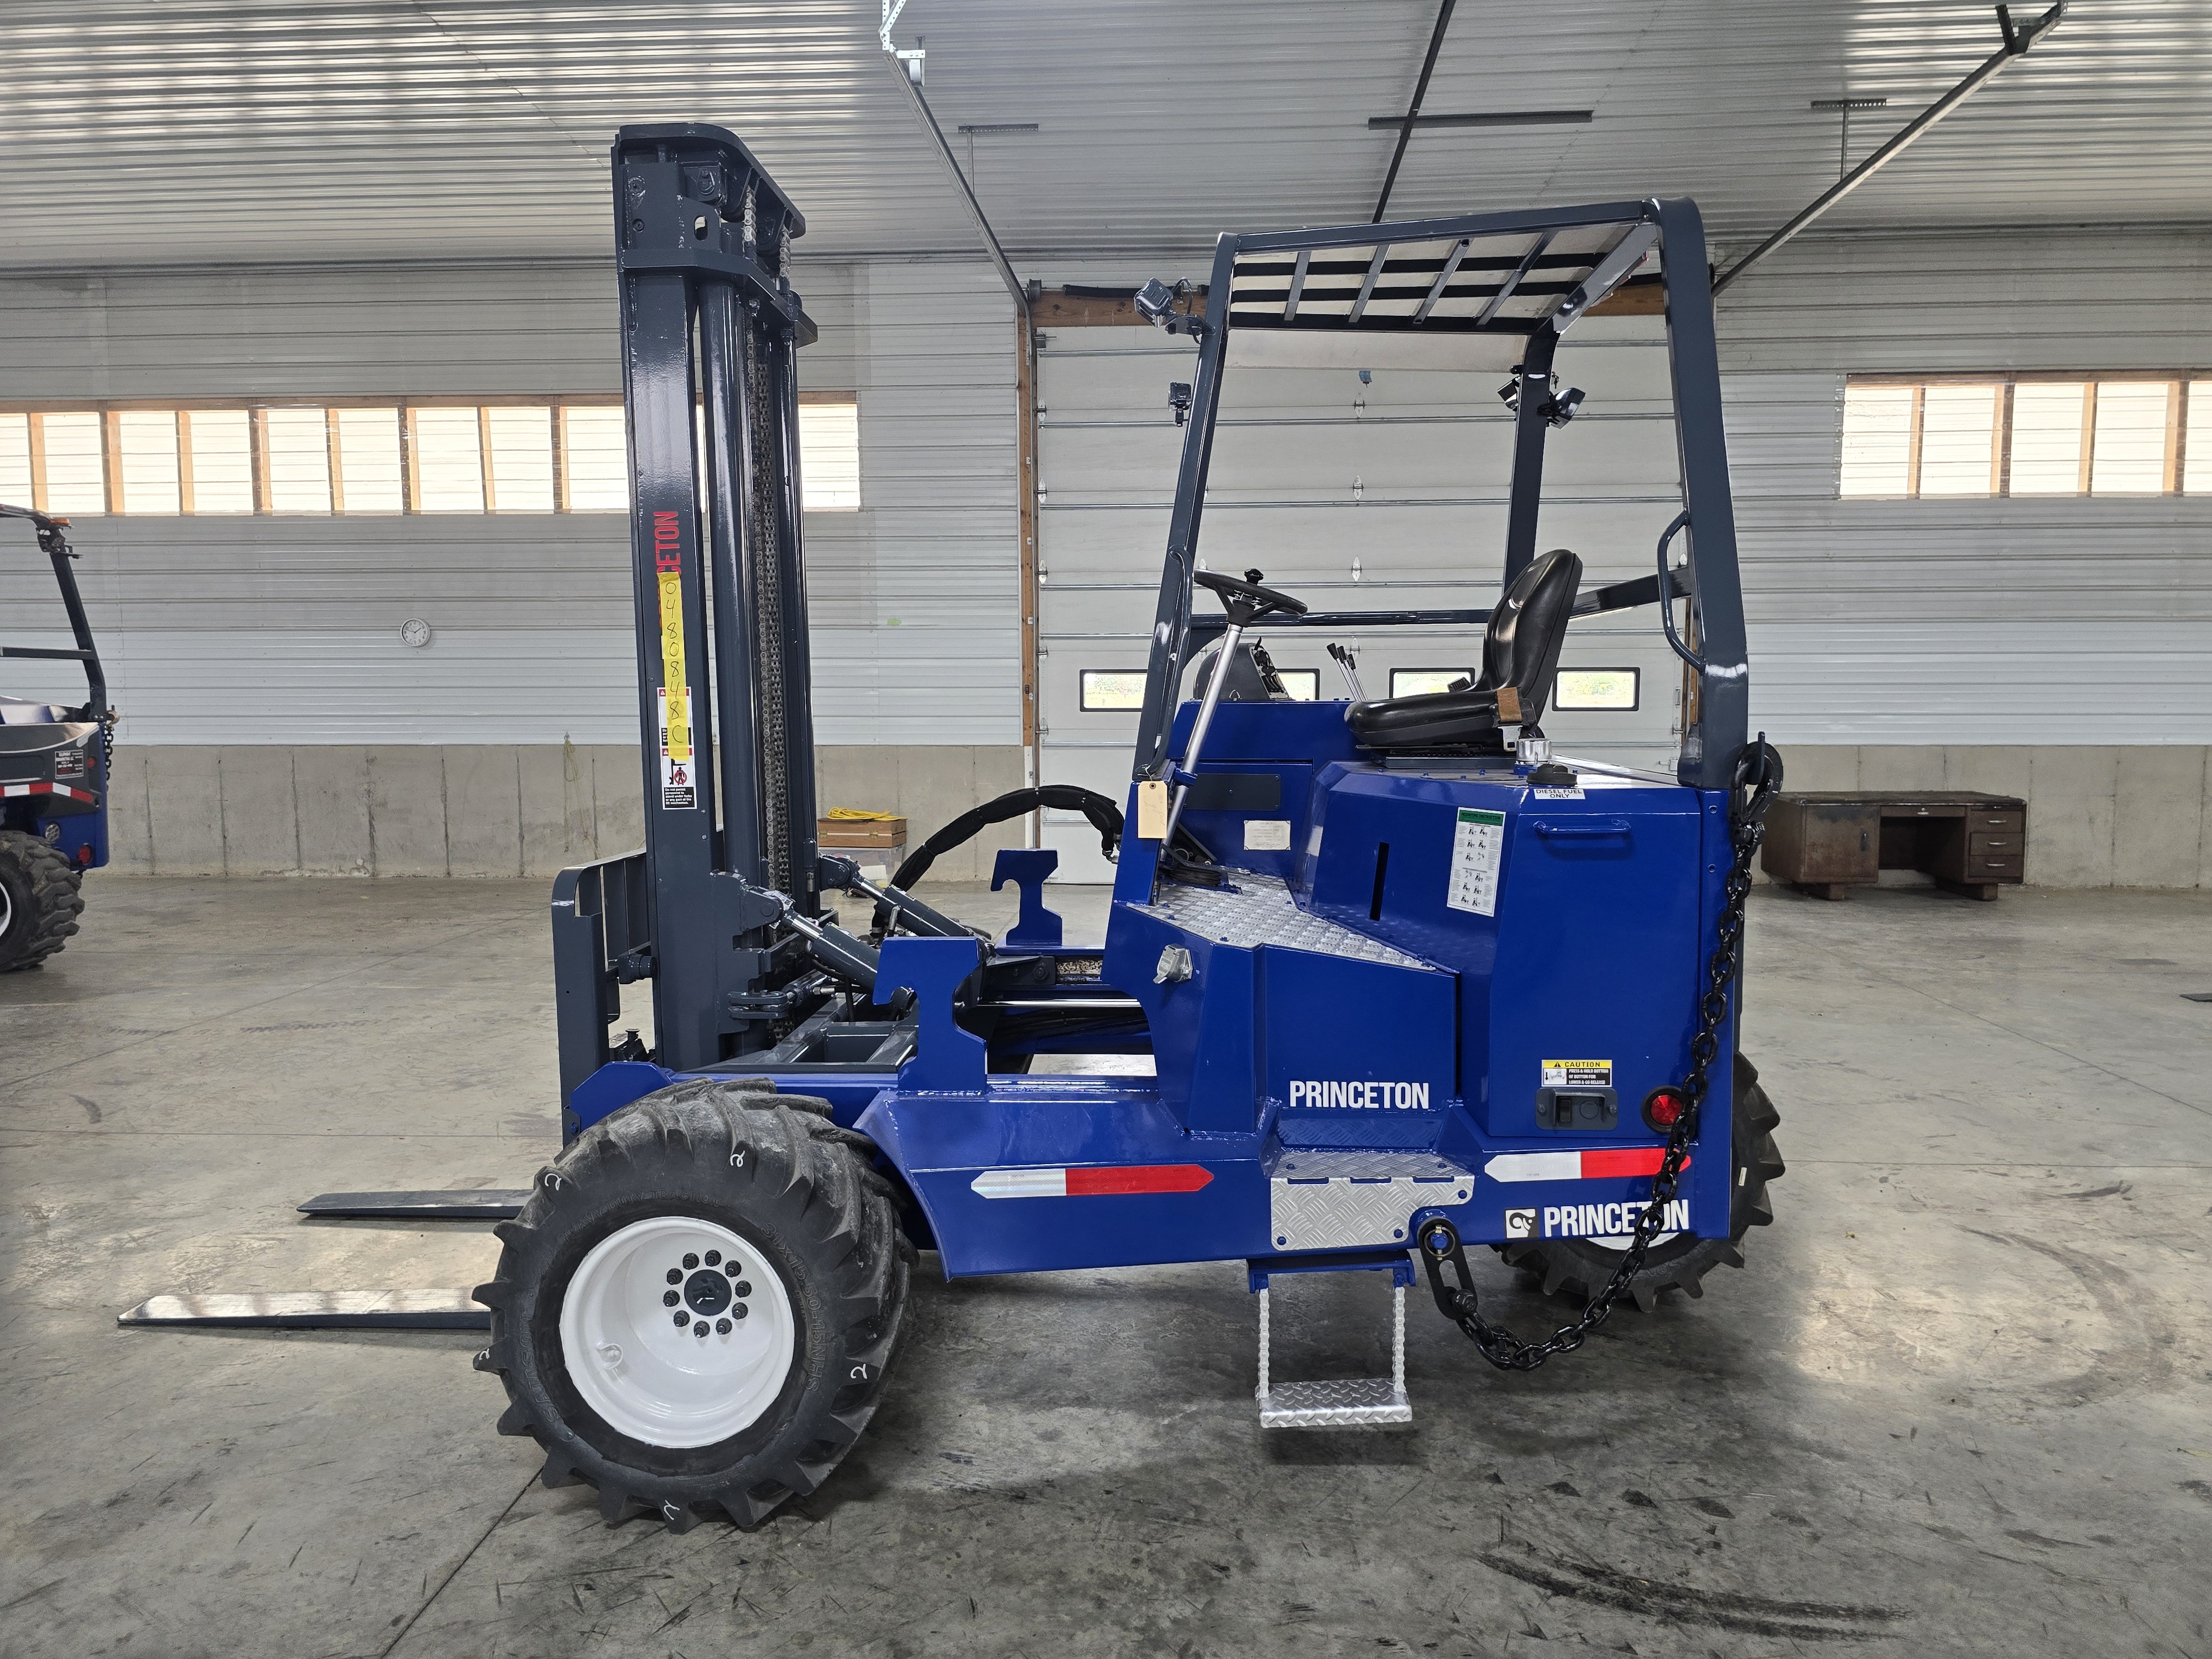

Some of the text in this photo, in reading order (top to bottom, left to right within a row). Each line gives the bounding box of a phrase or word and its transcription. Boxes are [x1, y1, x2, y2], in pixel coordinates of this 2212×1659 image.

[1290, 1081, 1428, 1109] PRINCETON
[608, 1191, 644, 1211] DUTY
[650, 1190, 721, 1207] TRACTION
